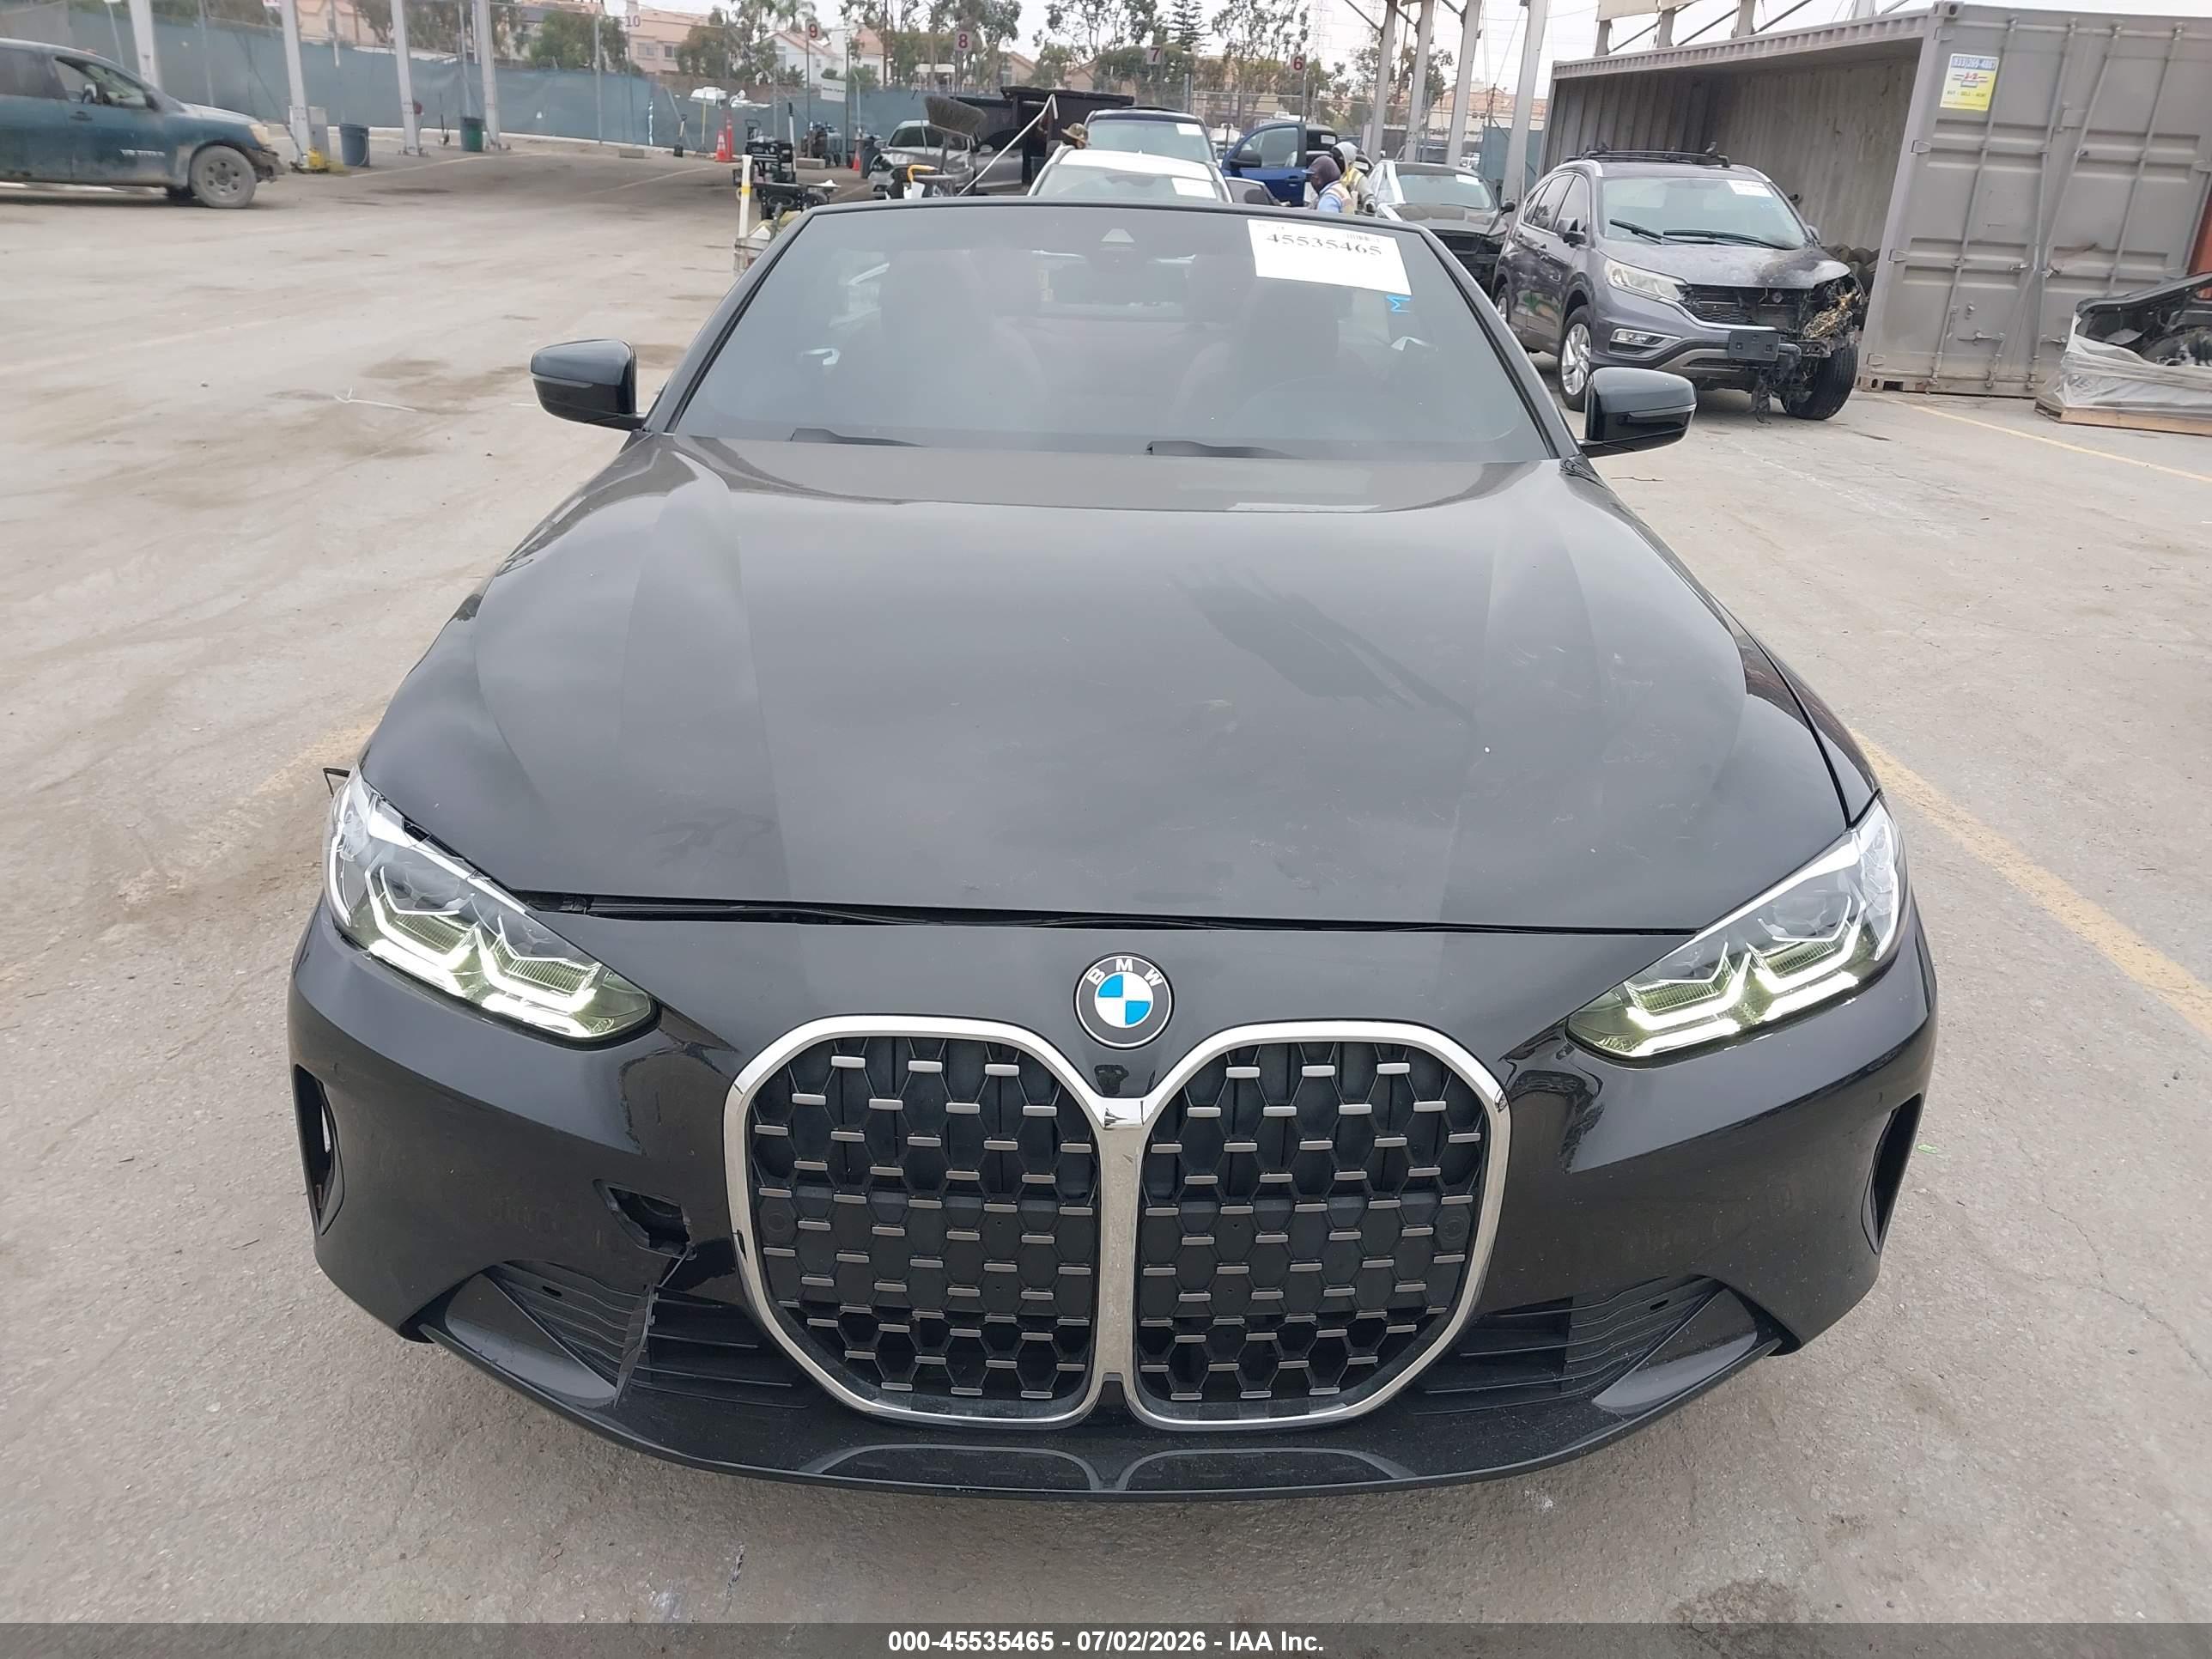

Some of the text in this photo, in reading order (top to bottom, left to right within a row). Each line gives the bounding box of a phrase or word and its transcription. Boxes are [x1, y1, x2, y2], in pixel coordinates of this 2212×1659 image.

[625, 15, 641, 27] 10
[809, 23, 817, 39] 9
[958, 33, 968, 49] 8
[1150, 46, 1161, 63] 7
[1293, 56, 1303, 70] 6
[1266, 233, 1382, 256] 45535465
[1086, 958, 1163, 988] BMW
